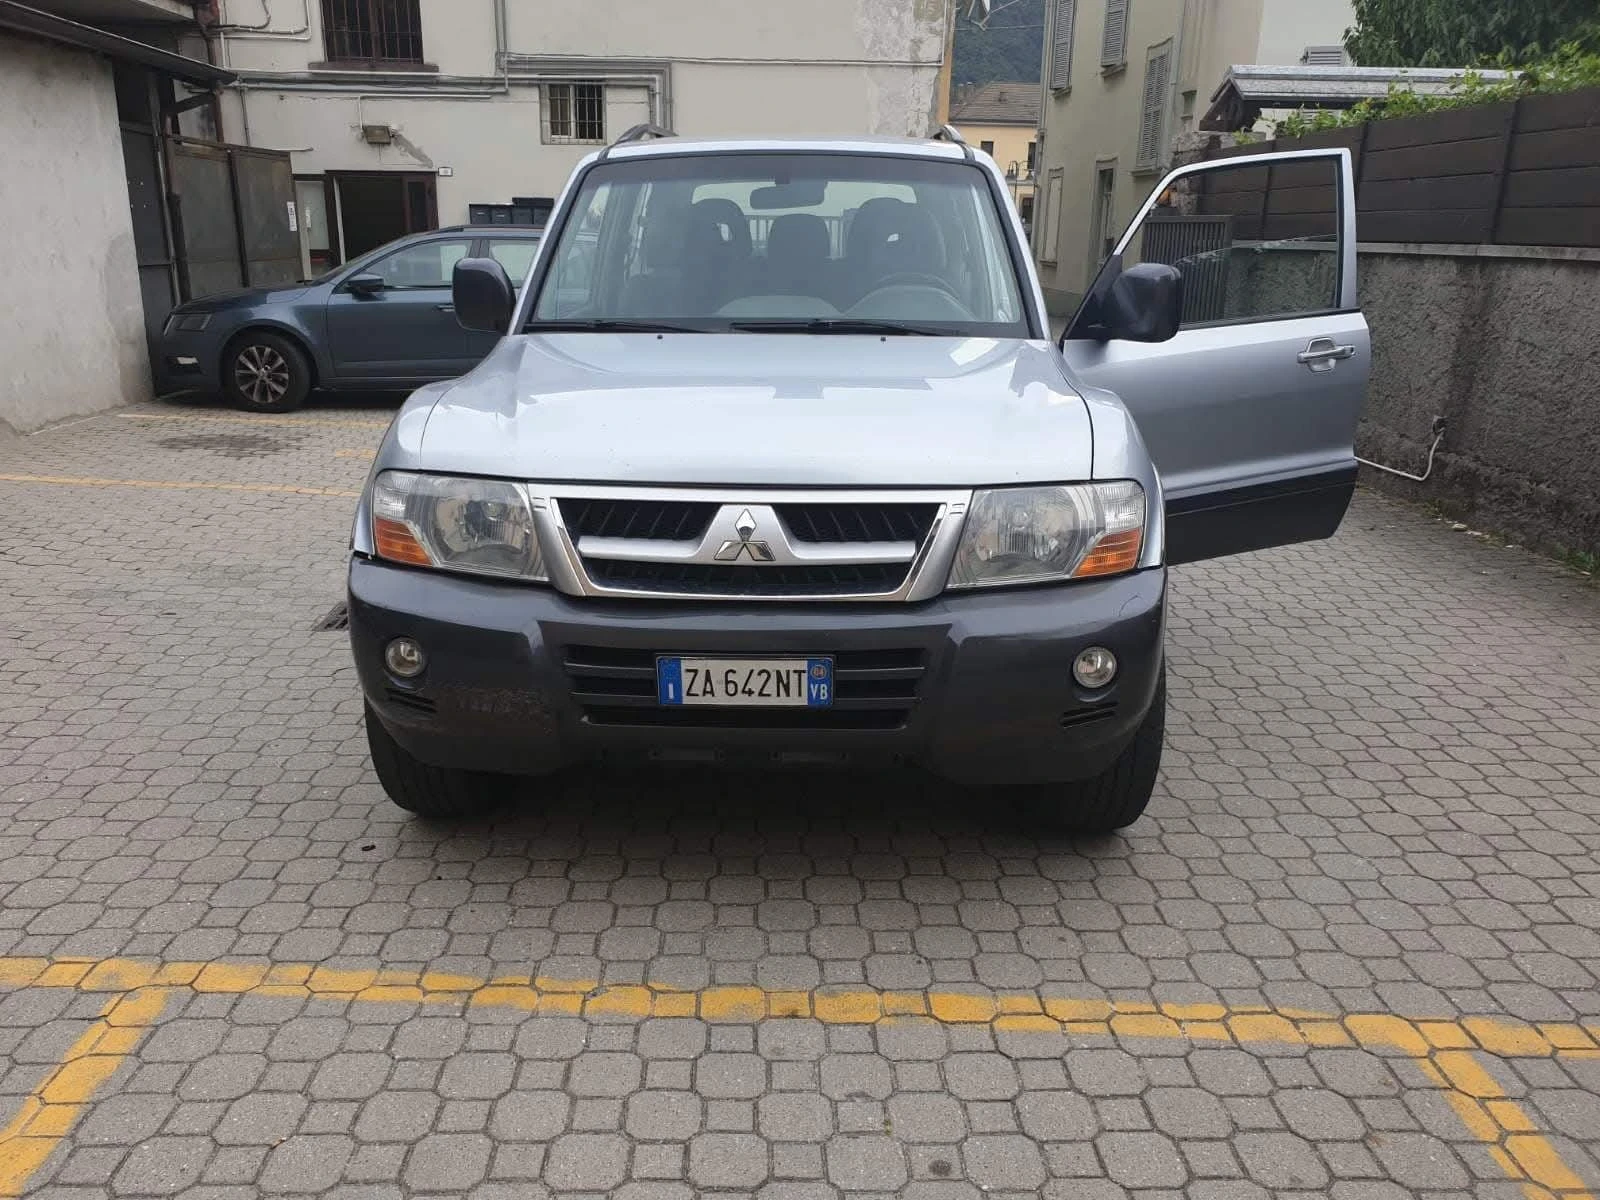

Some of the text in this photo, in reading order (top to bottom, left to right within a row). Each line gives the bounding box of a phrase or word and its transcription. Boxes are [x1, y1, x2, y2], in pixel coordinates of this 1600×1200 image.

[668, 683, 674, 699] I
[685, 669, 807, 697] ZA 642NT
[810, 683, 828, 700] VB
